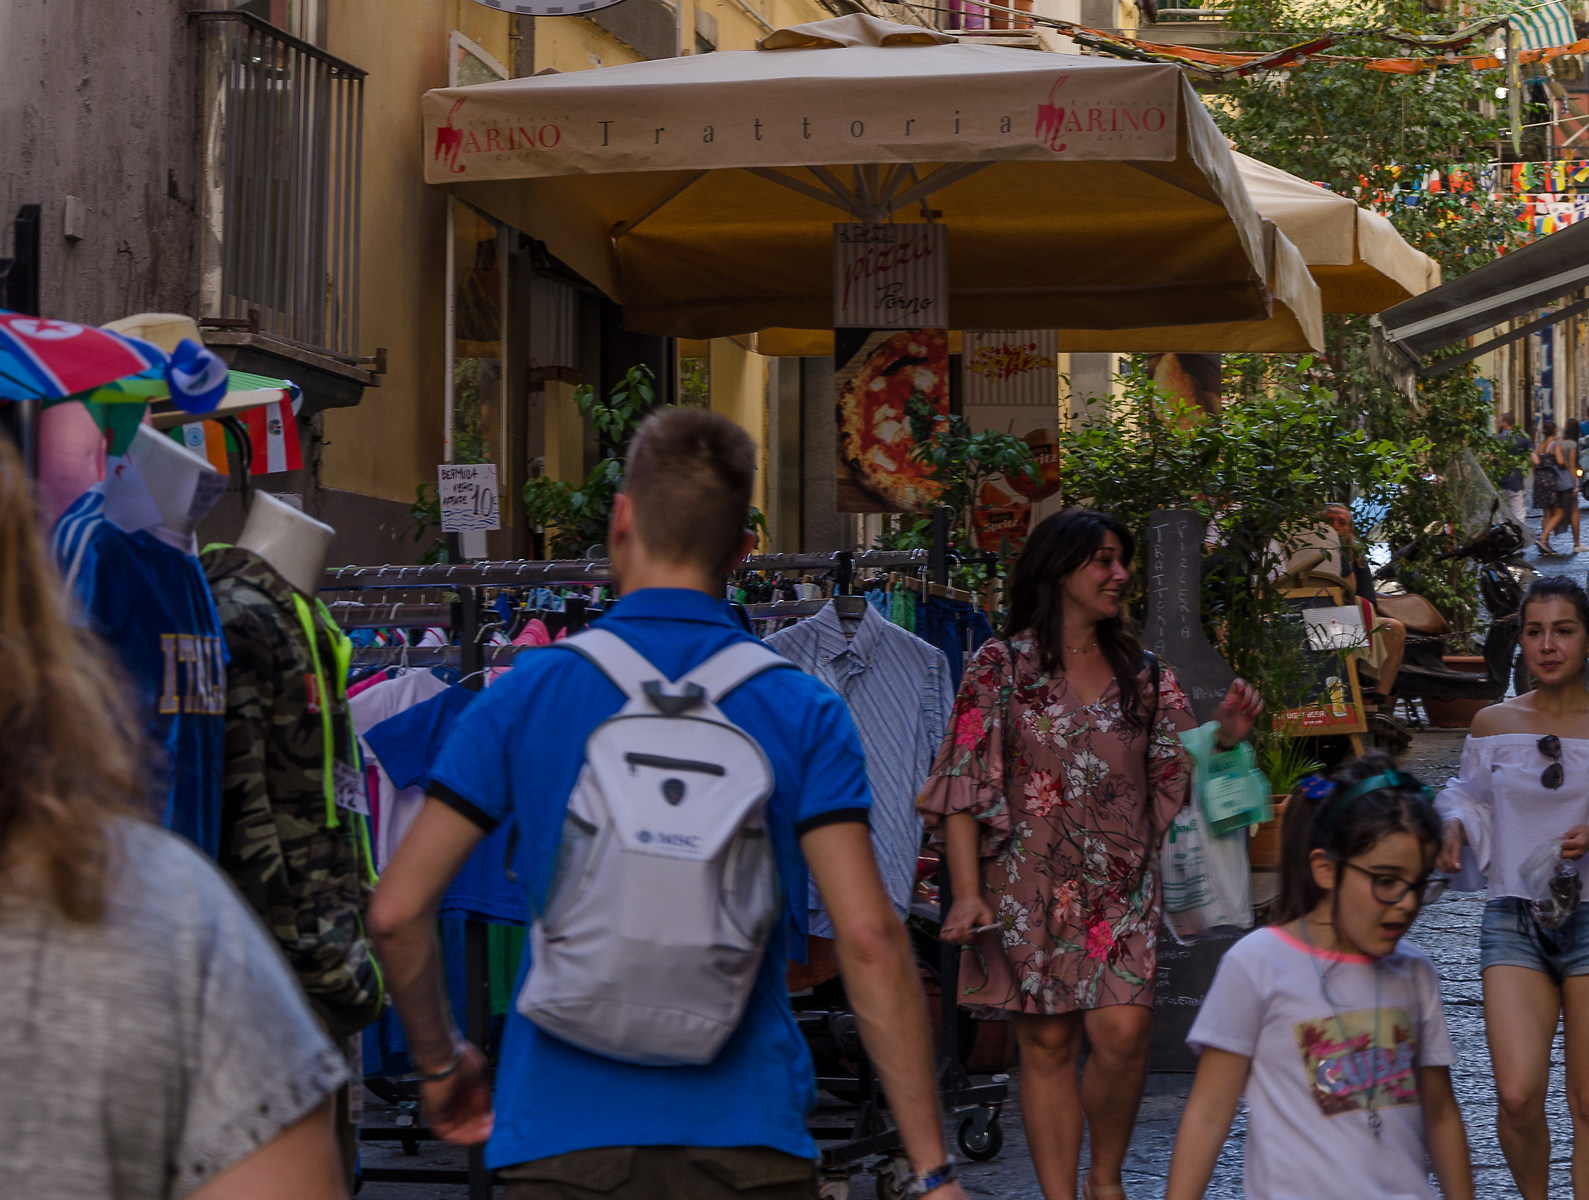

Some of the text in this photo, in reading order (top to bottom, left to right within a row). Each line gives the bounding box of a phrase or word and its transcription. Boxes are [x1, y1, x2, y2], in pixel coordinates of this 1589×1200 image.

[434, 123, 561, 175] MARINO
[1035, 104, 1166, 152] MARINO
[842, 233, 934, 312] pizza
[1031, 453, 1059, 466] ritz
